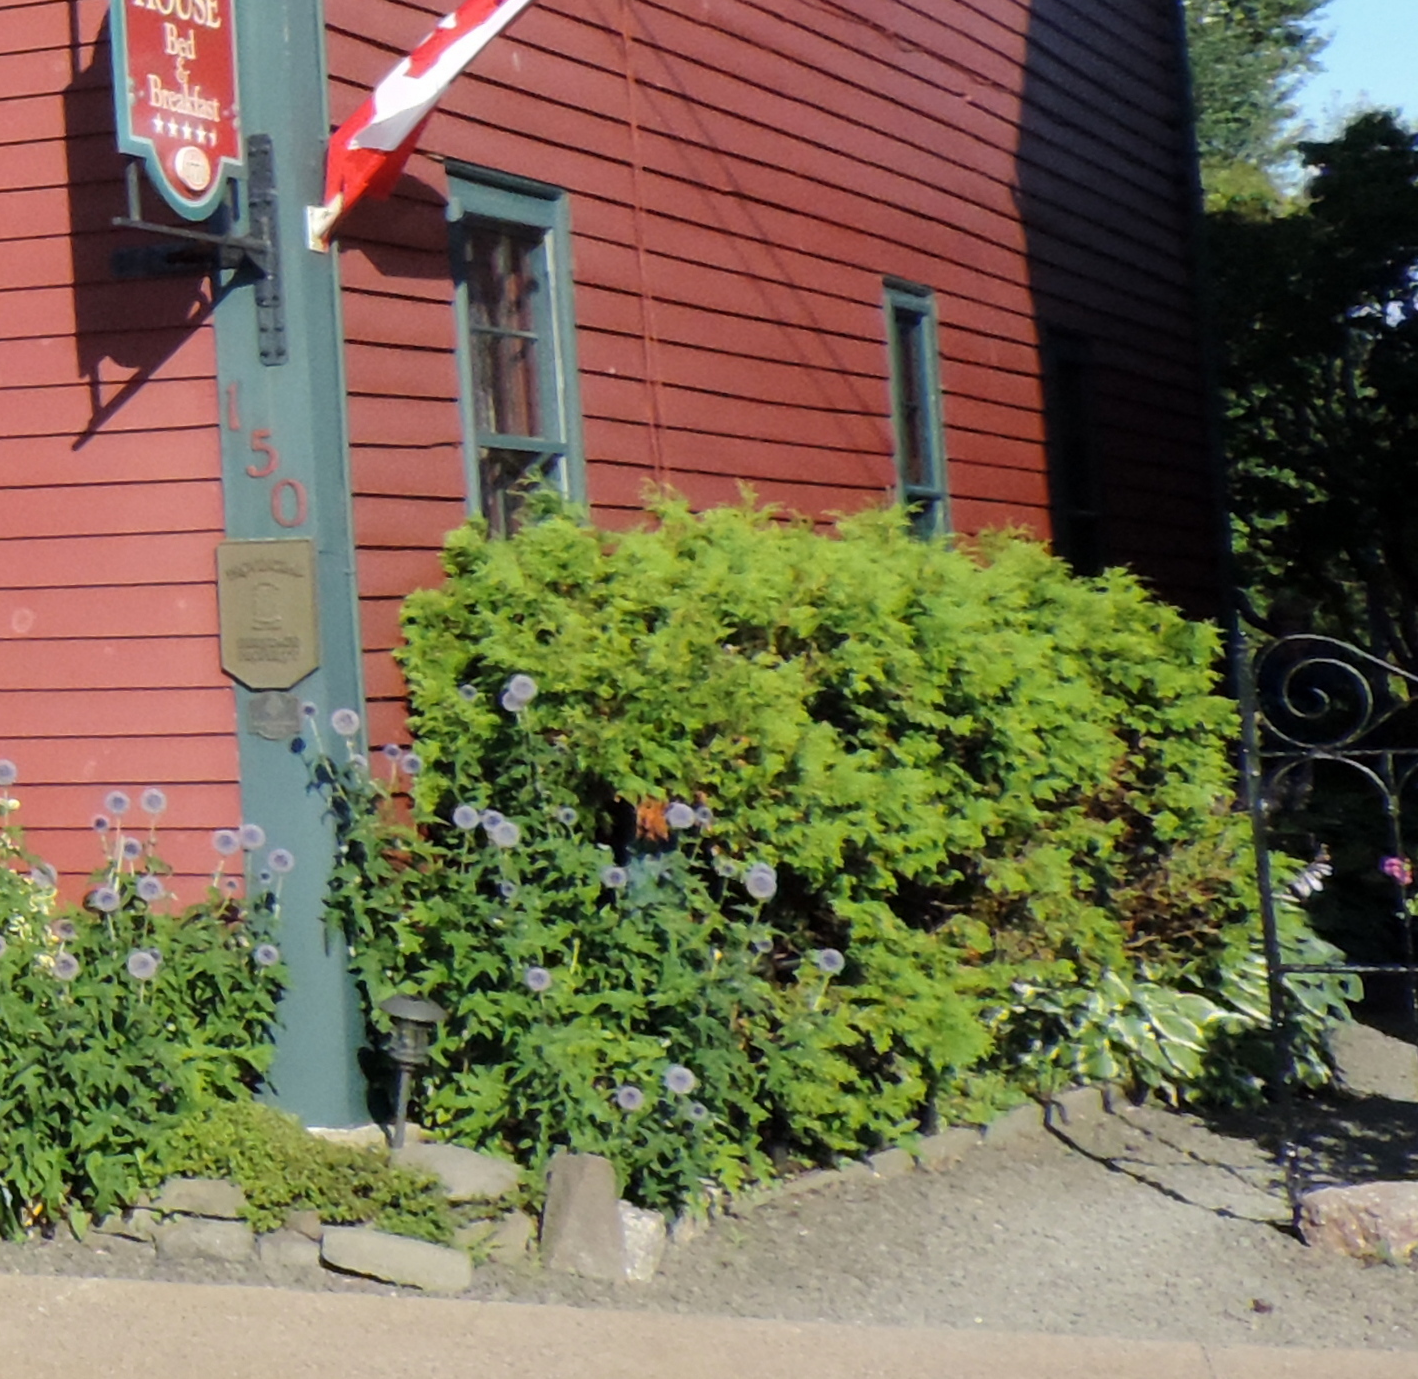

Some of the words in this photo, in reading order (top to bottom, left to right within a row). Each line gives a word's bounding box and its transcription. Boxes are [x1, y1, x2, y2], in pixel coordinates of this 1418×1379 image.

[164, 22, 196, 60] Bed
[175, 56, 190, 84] &
[147, 74, 221, 122] Breakfast
